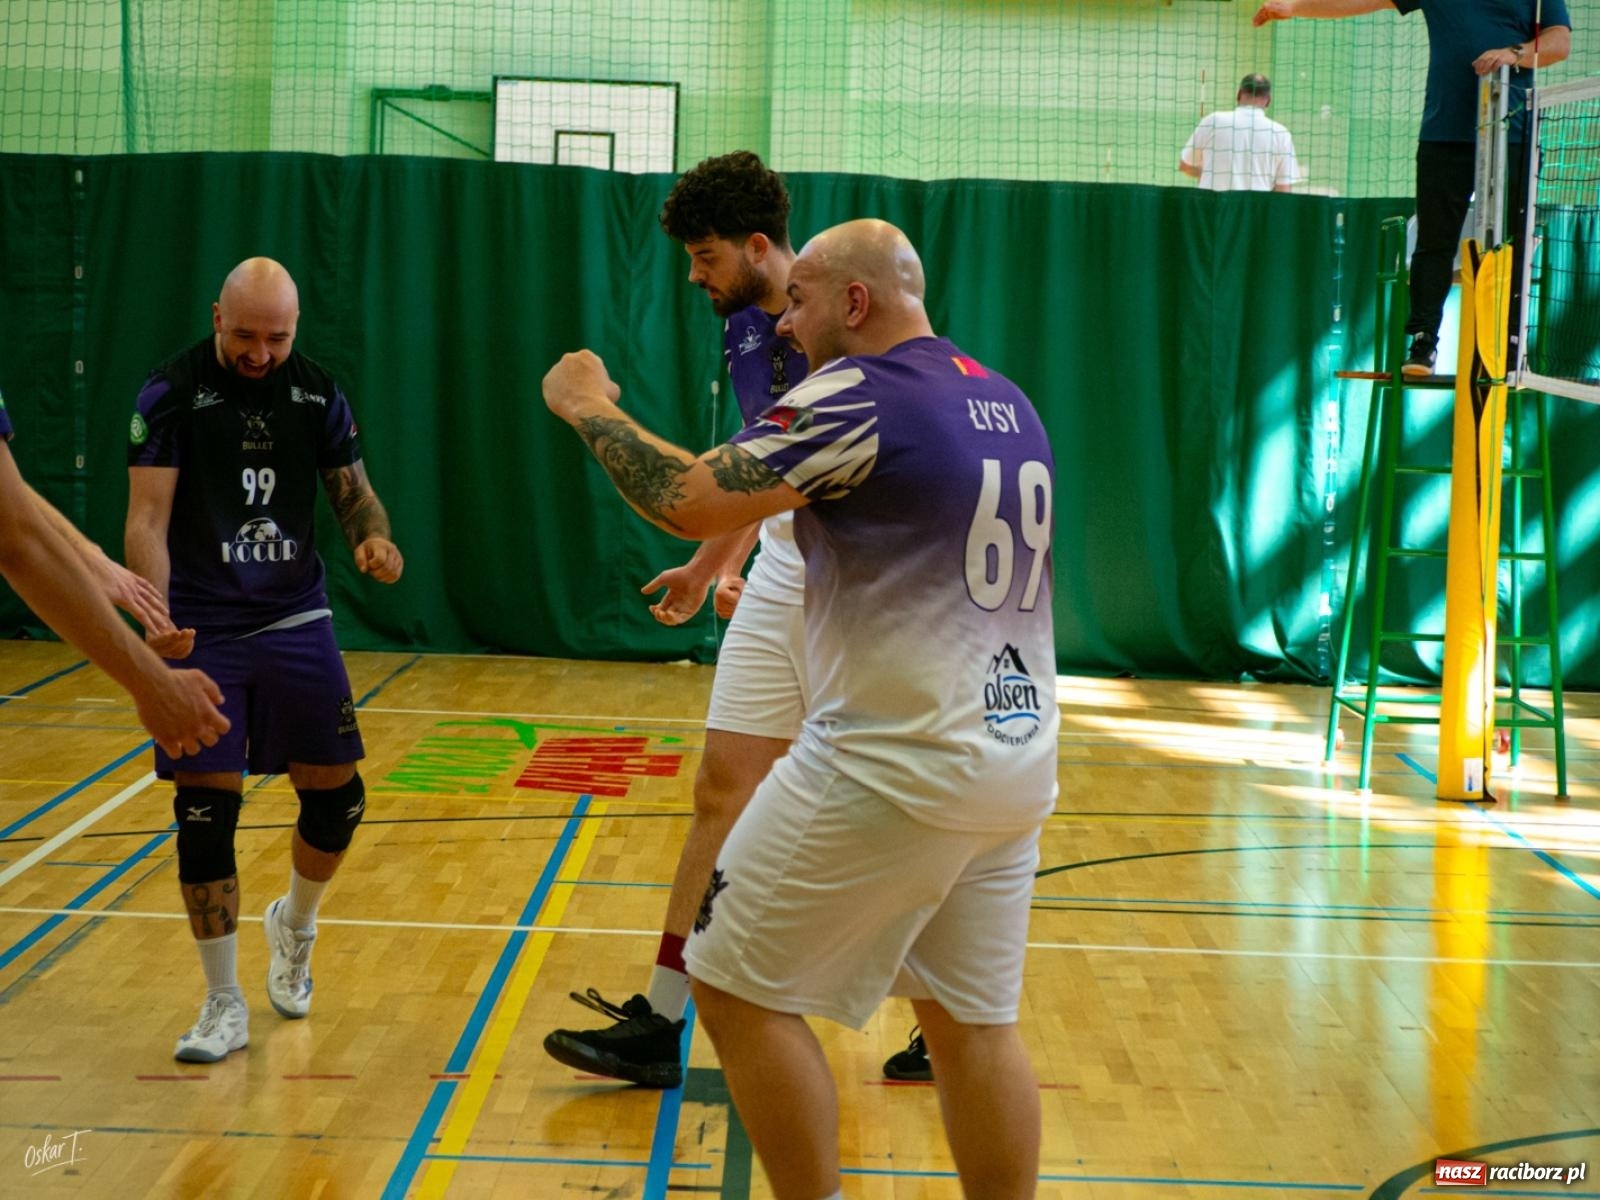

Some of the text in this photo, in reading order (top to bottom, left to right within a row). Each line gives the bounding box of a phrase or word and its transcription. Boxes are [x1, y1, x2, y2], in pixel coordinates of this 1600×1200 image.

[966, 398, 1021, 434] ŁYSY
[242, 441, 273, 450] BULLET
[241, 467, 276, 506] 99
[221, 540, 298, 564] KOCUR
[964, 458, 1053, 613] 69
[984, 673, 1041, 711] olsen
